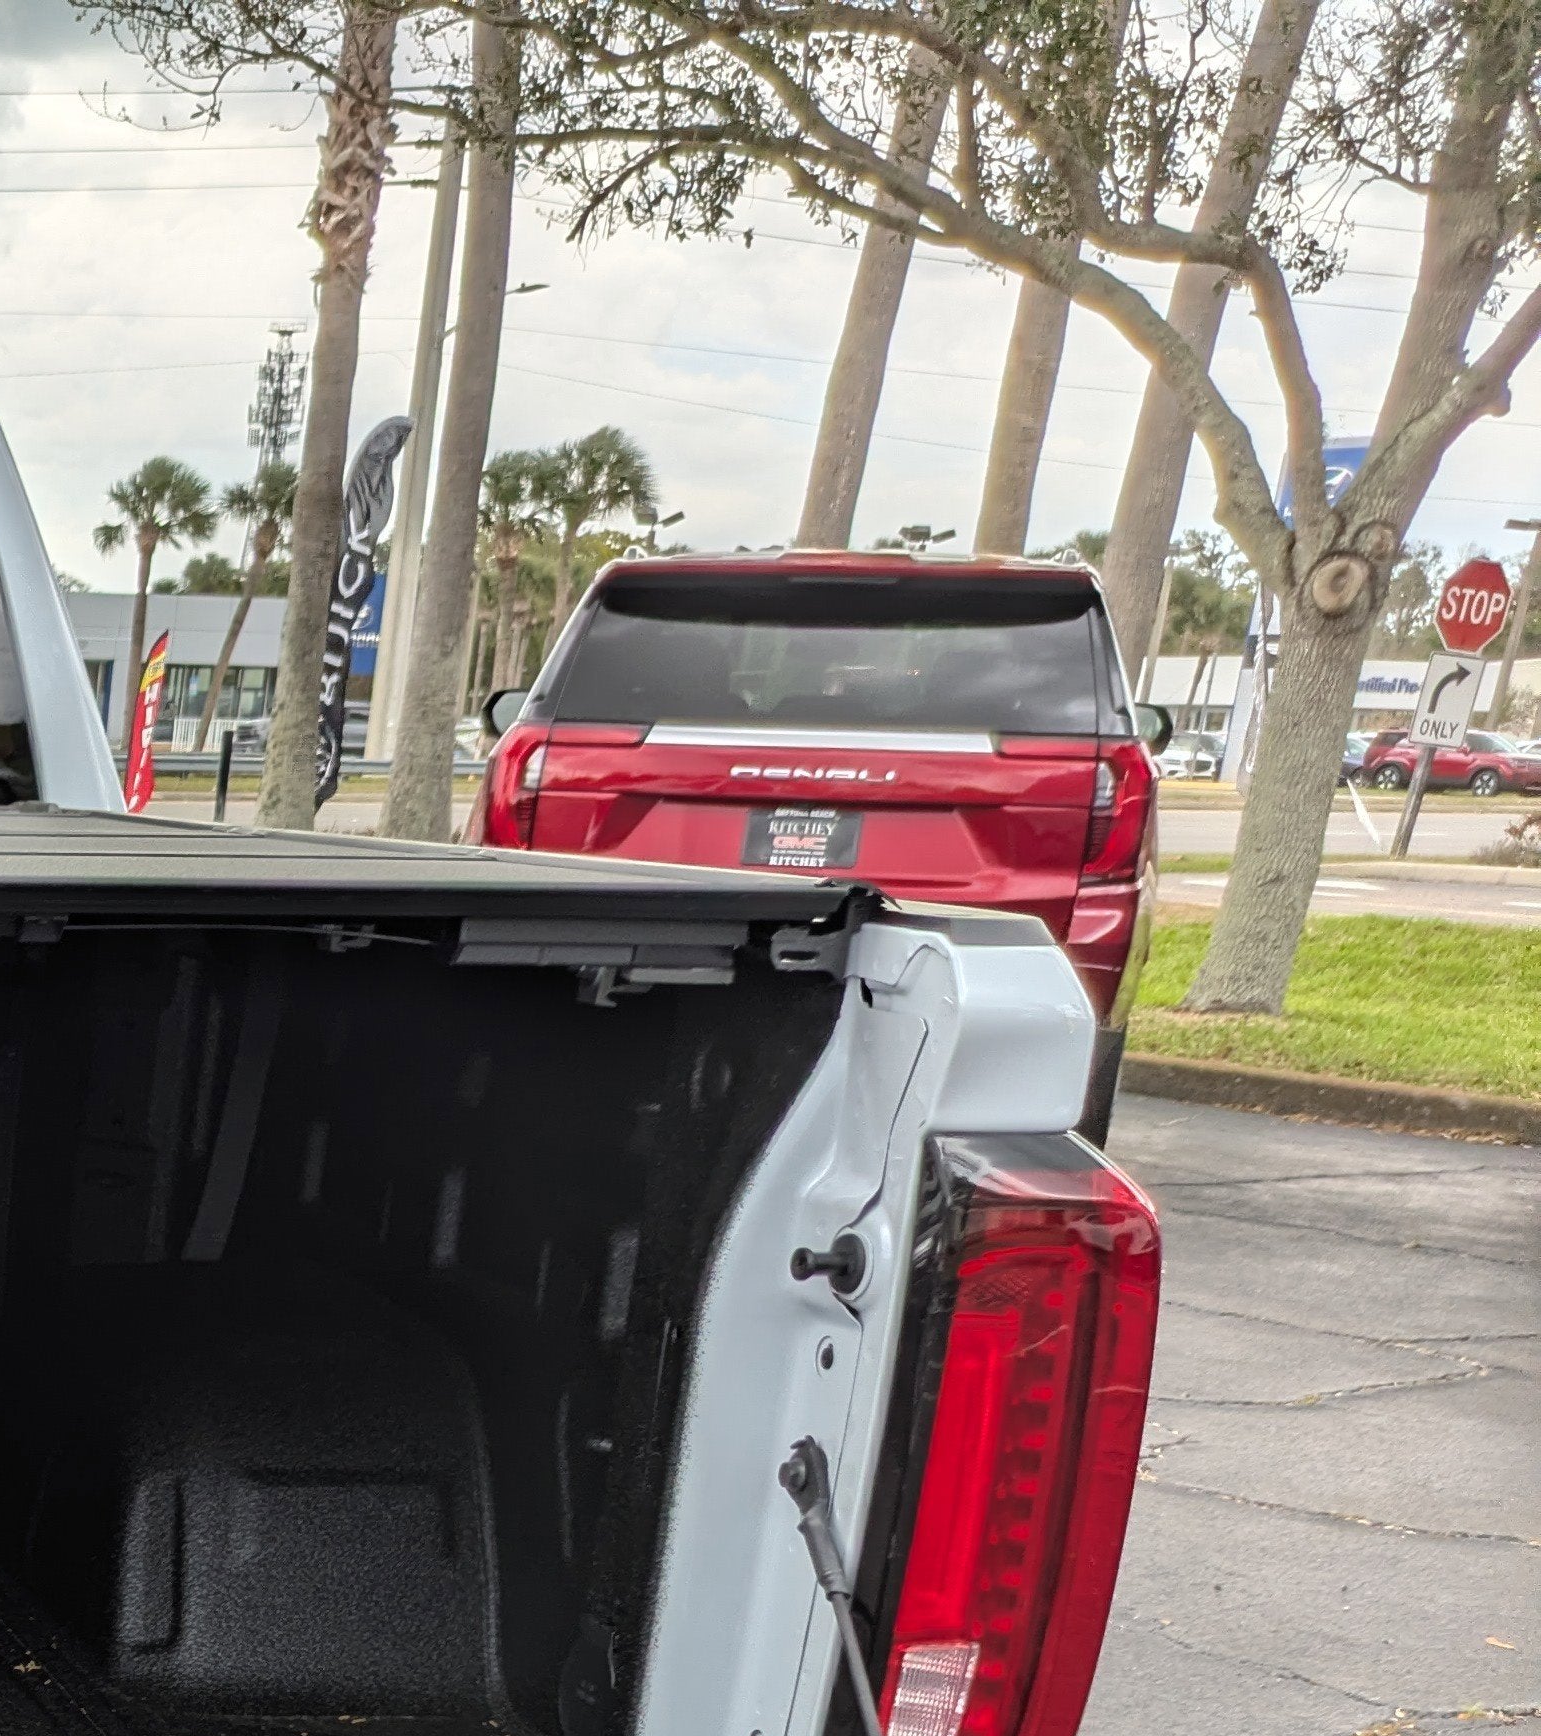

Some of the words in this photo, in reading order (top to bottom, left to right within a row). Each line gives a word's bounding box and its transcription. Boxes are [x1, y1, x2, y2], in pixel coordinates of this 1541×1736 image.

[1441, 586, 1506, 626] STOP
[1419, 718, 1460, 740] ONLY
[730, 766, 896, 782] DENALI
[768, 820, 837, 836] RITCHEY
[772, 836, 827, 850] GMC
[768, 856, 827, 868] RITCHEY
